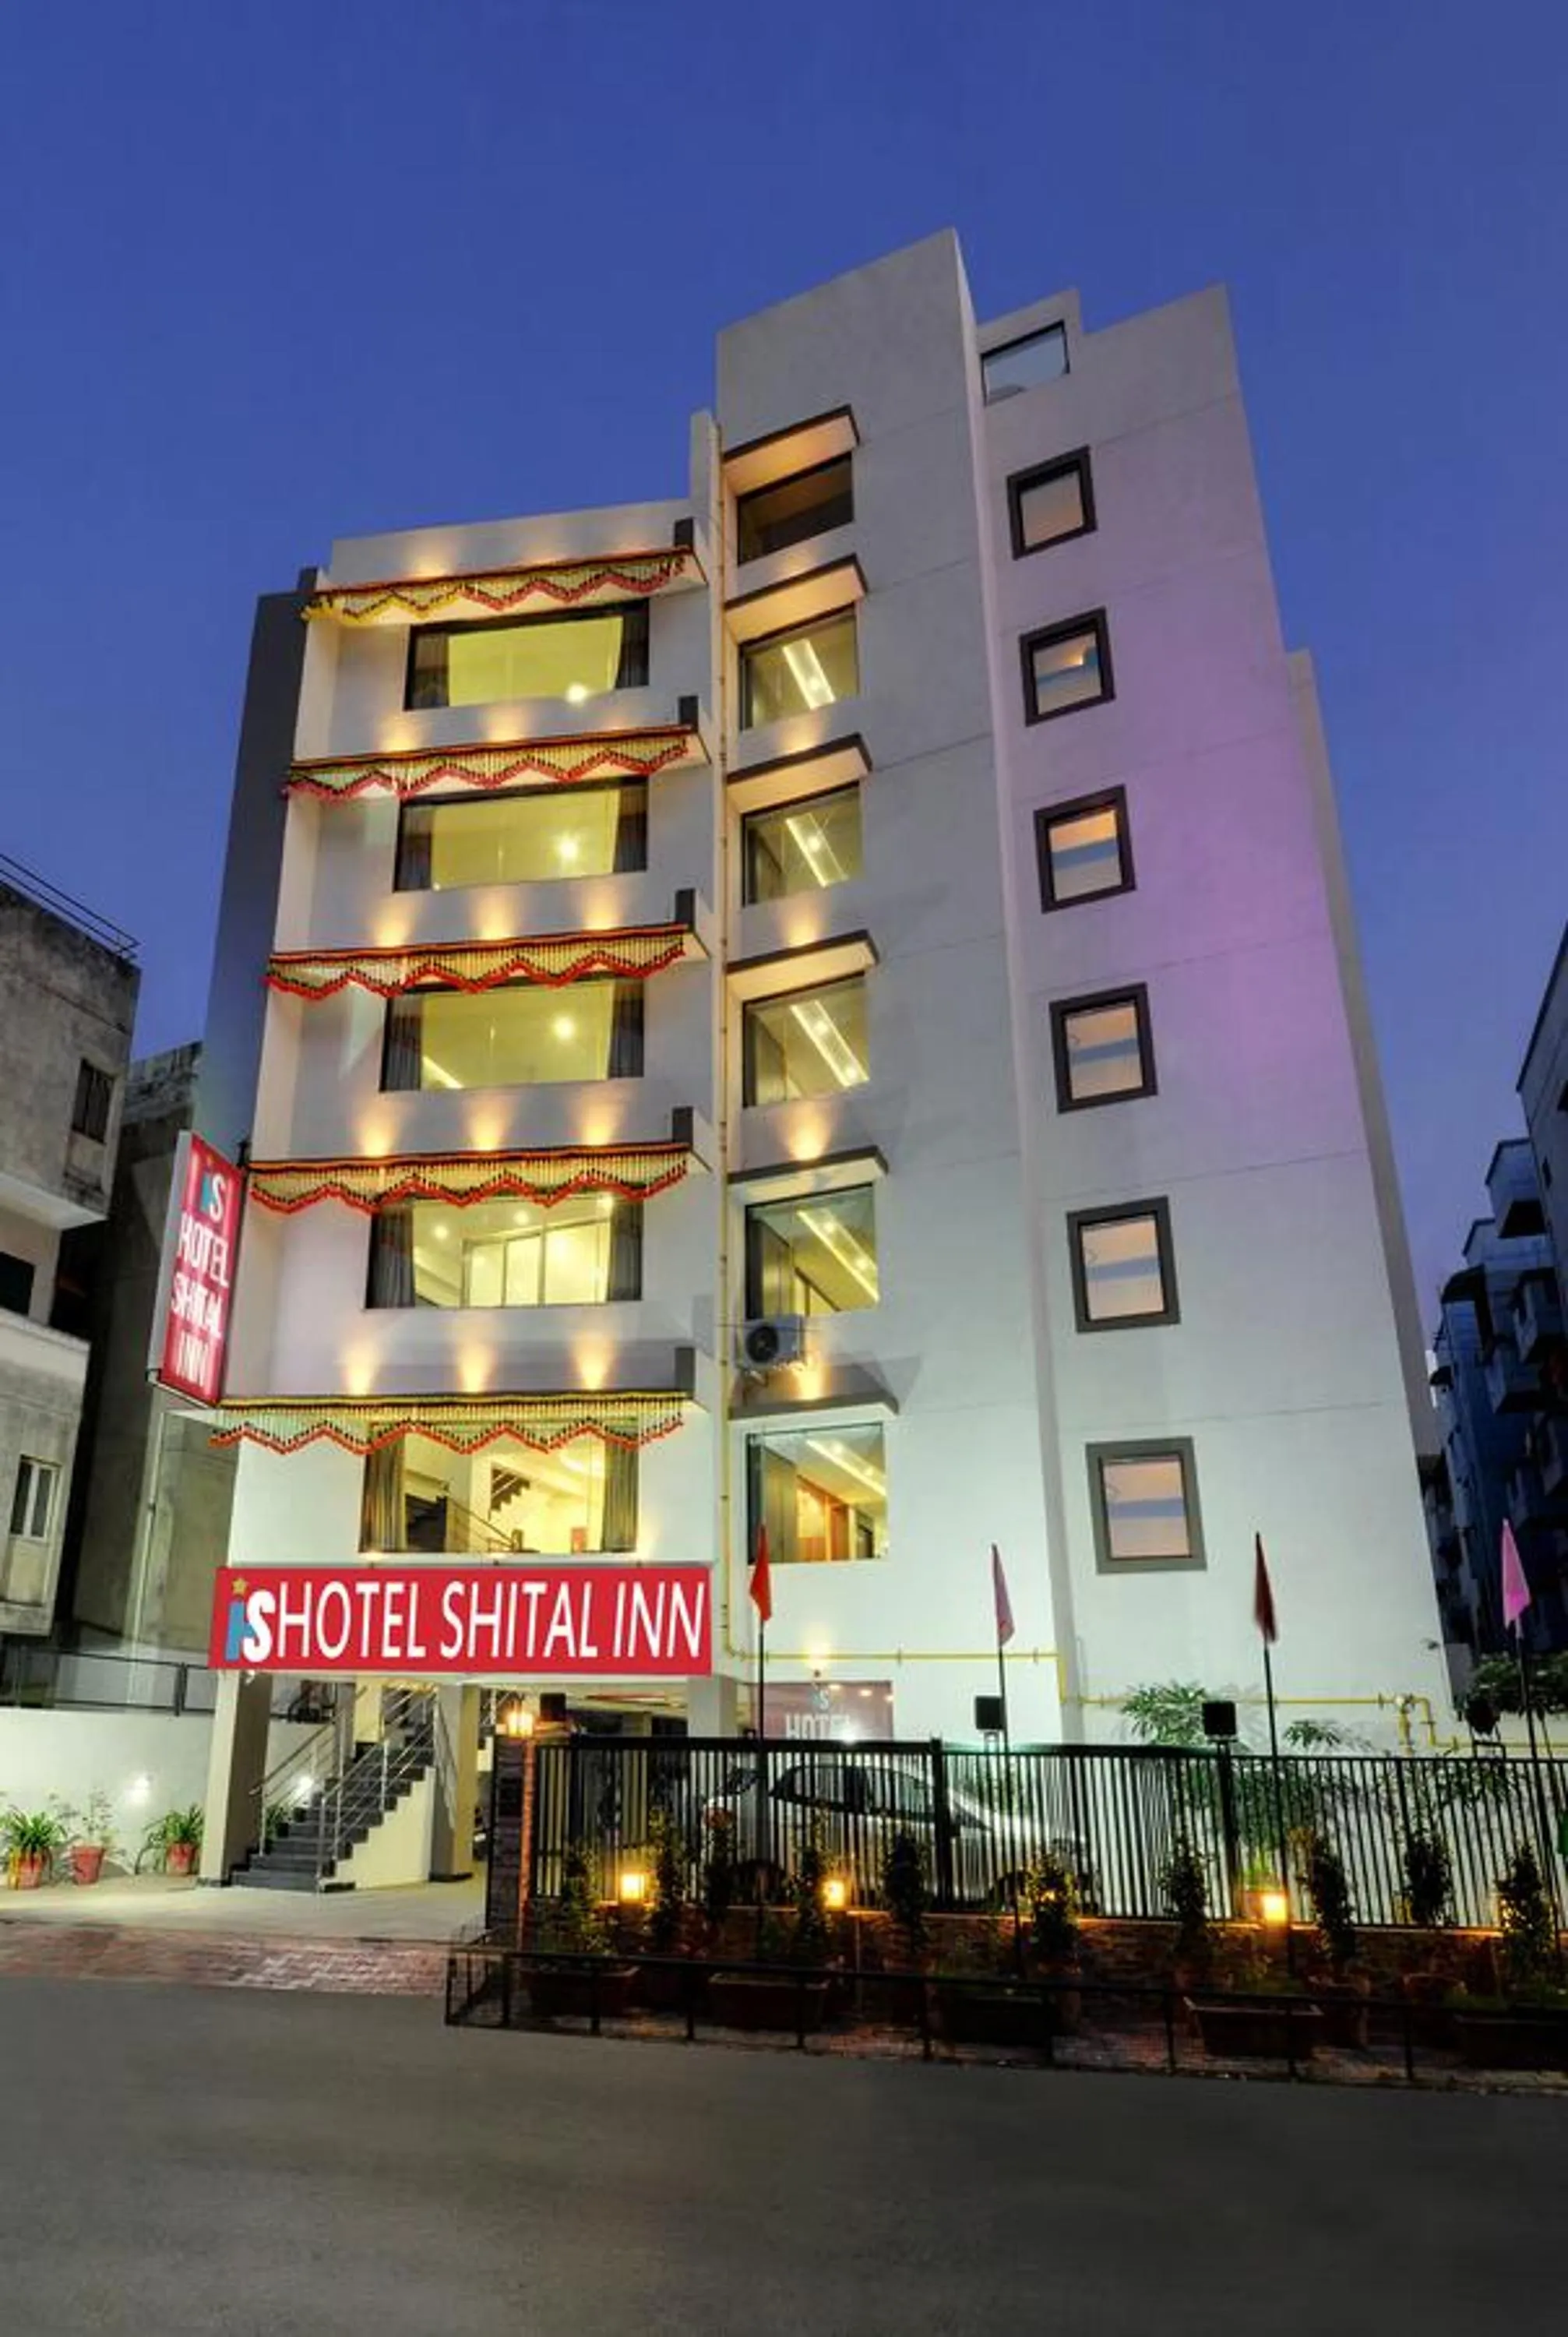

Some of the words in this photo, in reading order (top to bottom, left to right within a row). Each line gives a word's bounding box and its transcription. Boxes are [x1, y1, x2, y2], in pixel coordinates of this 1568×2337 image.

[178, 1212, 229, 1288] HOTEL
[172, 1271, 223, 1340] SHITAL
[177, 1331, 210, 1387] INN
[277, 1581, 426, 1658] HOTEL
[439, 1581, 598, 1658] SHITAL
[612, 1581, 704, 1658] INN
